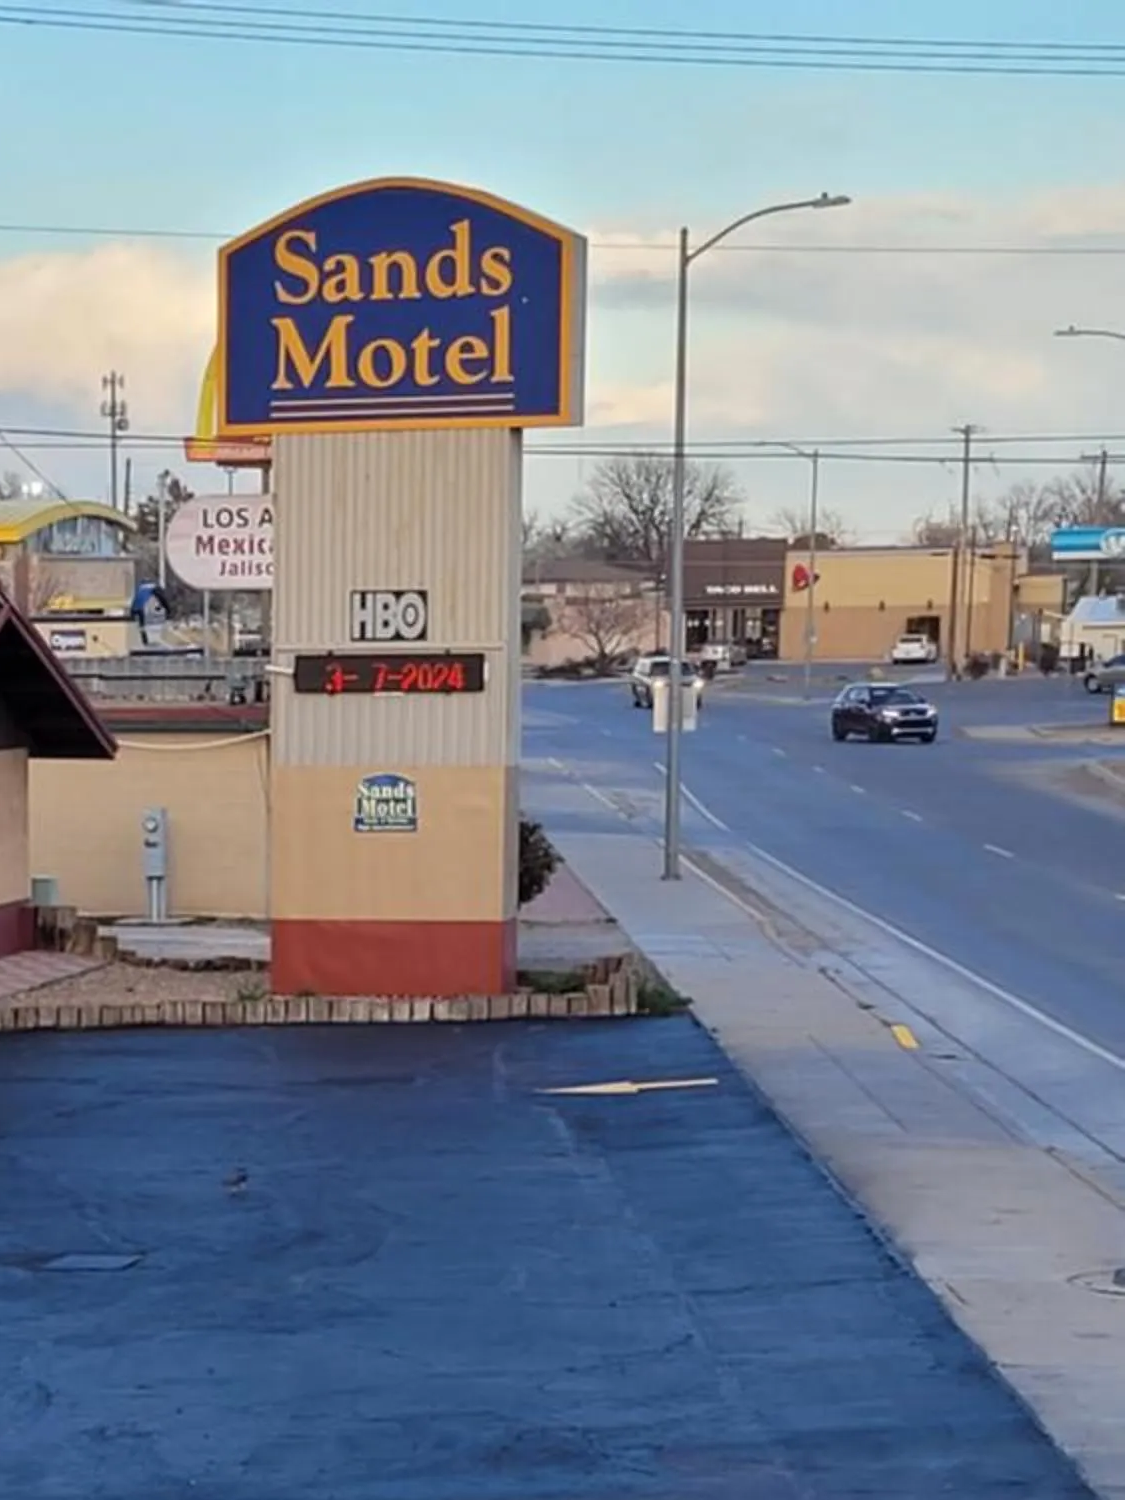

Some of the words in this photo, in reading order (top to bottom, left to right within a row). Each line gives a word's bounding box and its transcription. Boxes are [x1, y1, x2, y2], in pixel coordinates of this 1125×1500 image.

[274, 218, 513, 305] Sands
[270, 304, 516, 390] Motel
[202, 507, 250, 529] LOS
[195, 533, 273, 556] Mexic
[352, 592, 426, 639] HBO
[362, 799, 413, 817] Motel
